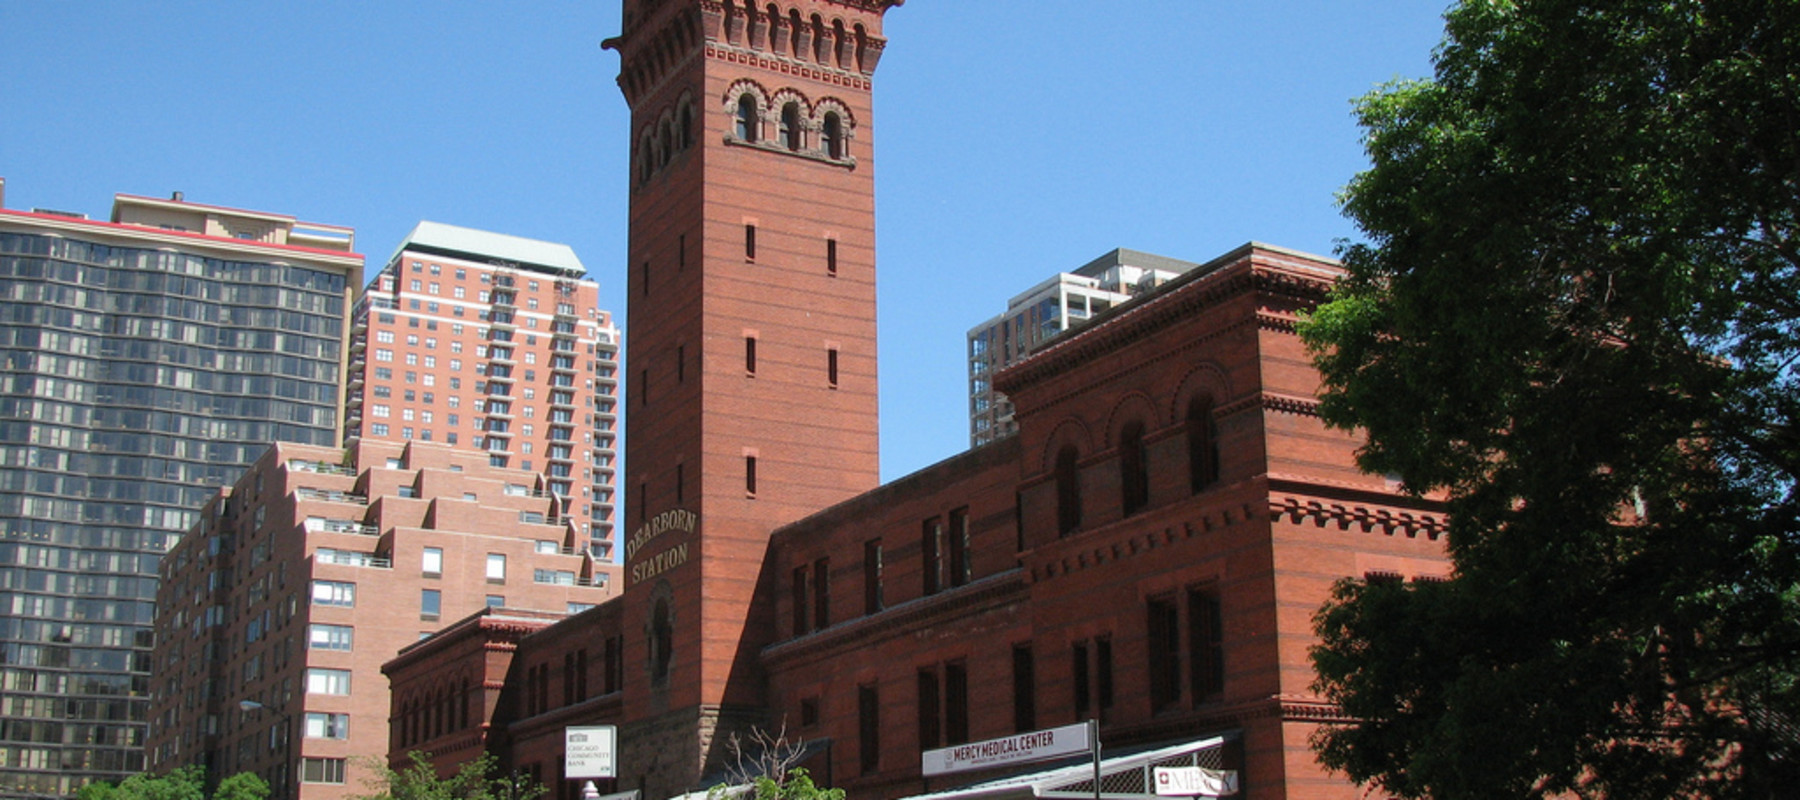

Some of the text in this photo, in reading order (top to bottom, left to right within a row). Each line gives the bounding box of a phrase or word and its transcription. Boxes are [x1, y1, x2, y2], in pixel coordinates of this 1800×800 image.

[626, 509, 697, 560] DEARBORN
[632, 542, 688, 584] STATION
[954, 744, 981, 761] MERCY
[982, 738, 1018, 757] MEDICAL
[1020, 731, 1054, 750] CENTER
